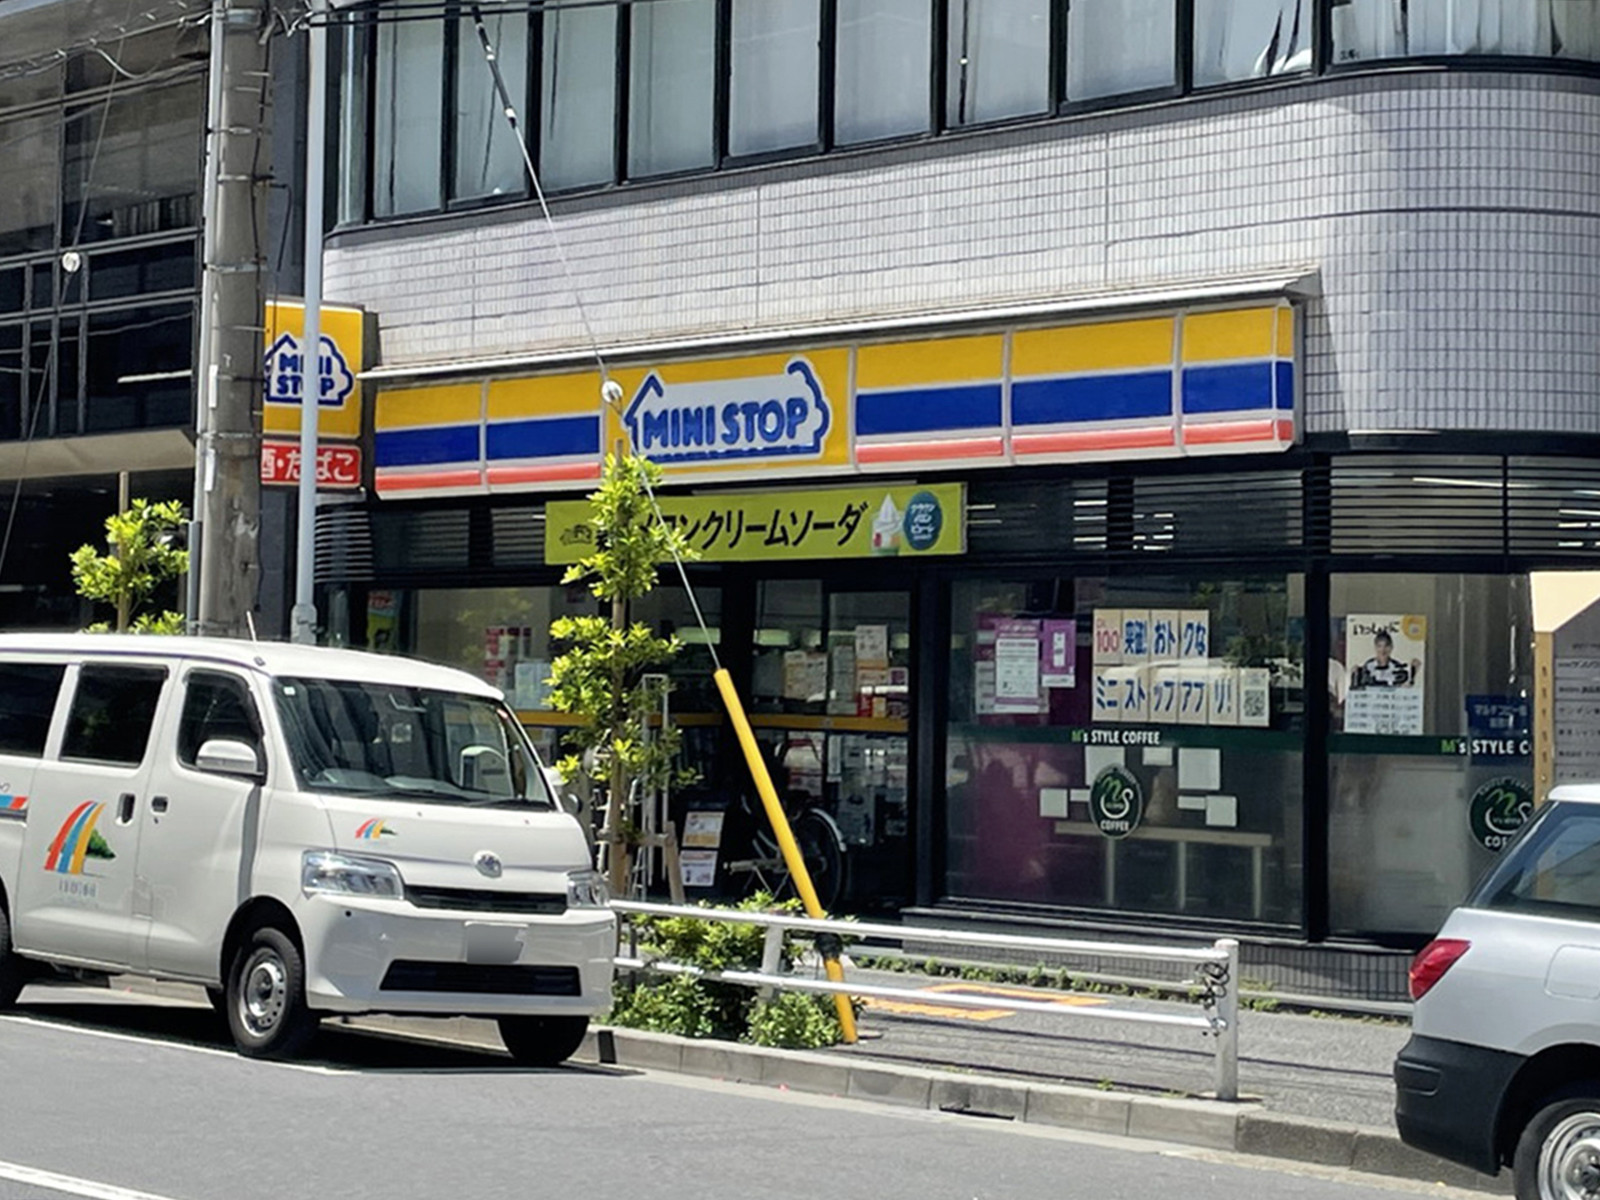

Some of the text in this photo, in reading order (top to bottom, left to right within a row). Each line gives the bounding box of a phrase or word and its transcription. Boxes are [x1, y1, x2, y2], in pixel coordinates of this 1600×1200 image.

[276, 374, 335, 396] STP
[642, 396, 809, 449] MINI STOP
[1090, 729, 1120, 744] STYLE
[1121, 730, 1161, 745] COFFEE
[1441, 739, 1467, 754] M's
[1472, 740, 1515, 755] STYLE
